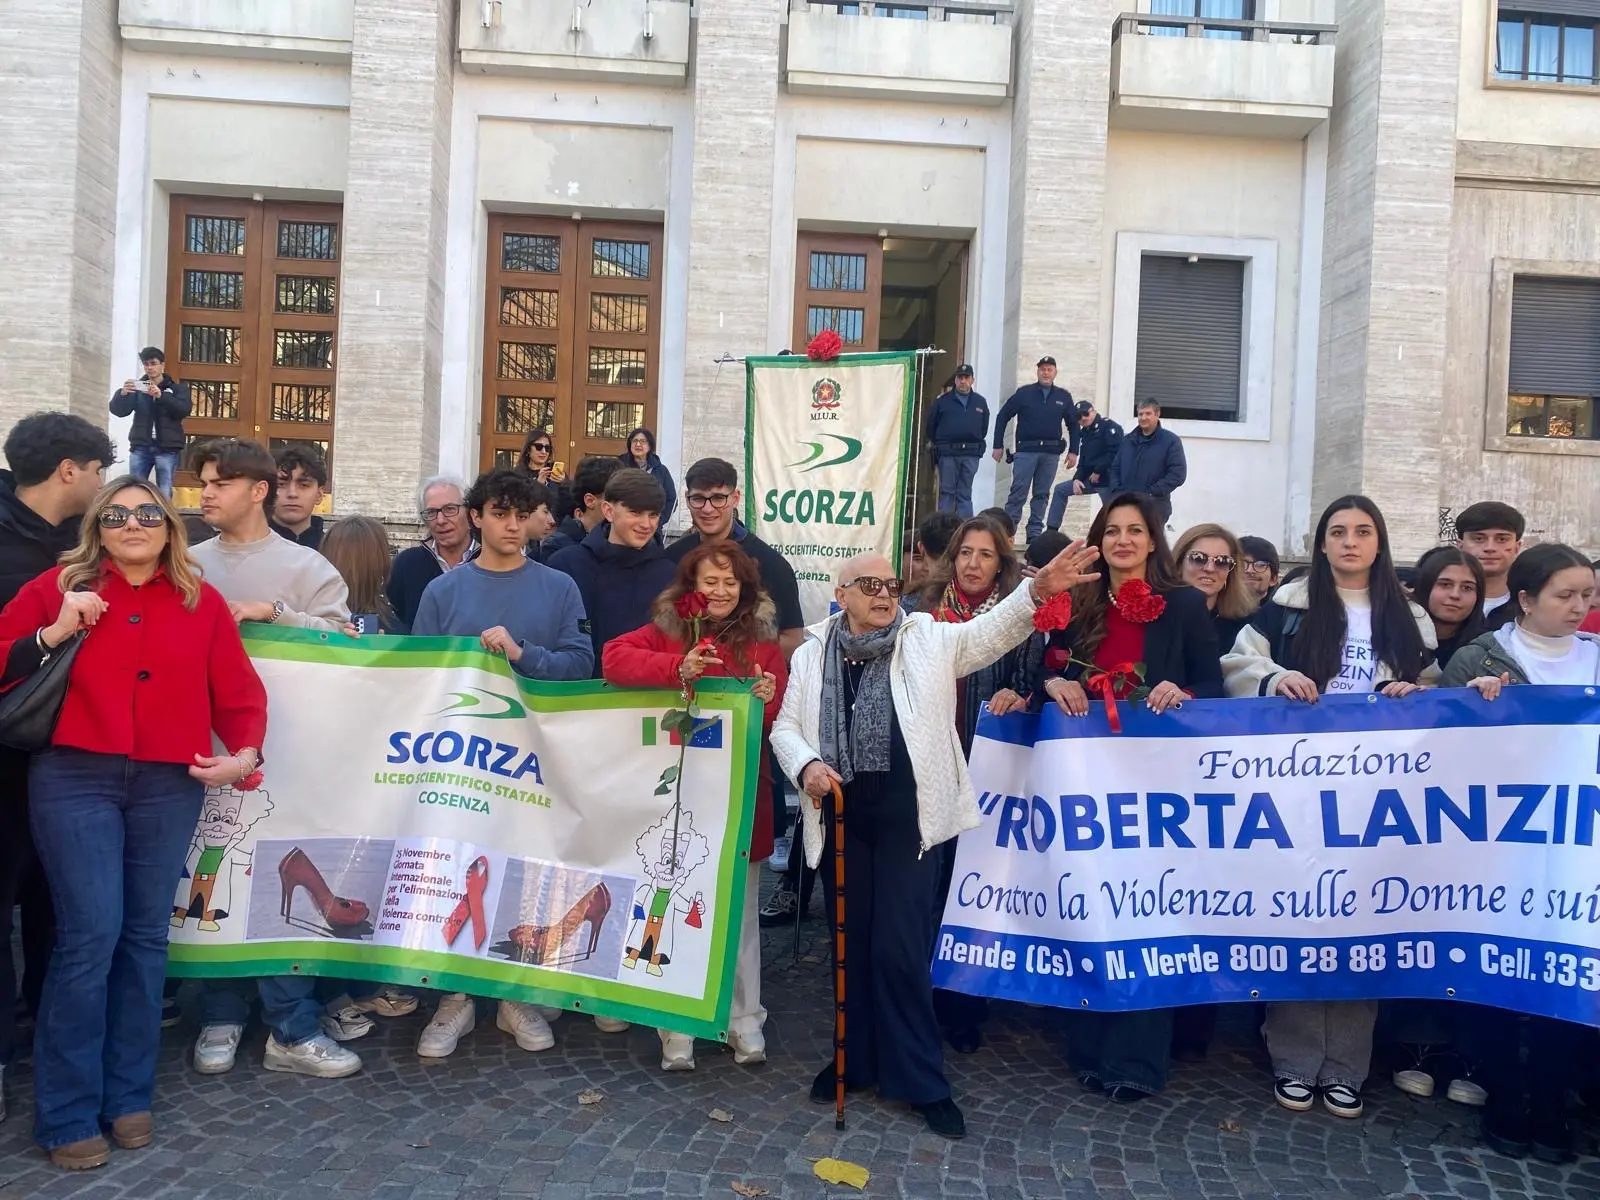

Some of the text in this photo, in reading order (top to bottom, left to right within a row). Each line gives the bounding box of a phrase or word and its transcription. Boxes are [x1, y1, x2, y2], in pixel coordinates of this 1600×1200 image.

[762, 488, 876, 526] SCORZA
[784, 544, 833, 557] SCIENTIFICO
[794, 570, 831, 582] Cosenza
[1346, 645, 1374, 661] ERT
[1339, 664, 1374, 682] ZIN
[1330, 681, 1354, 690] ODV
[386, 730, 545, 786] SCORZA
[1198, 738, 1432, 780] Fondazione
[374, 771, 552, 808] LICEO SCIENTIFICO STATALE
[418, 790, 490, 815] COSENZA
[402, 848, 451, 861] Novembre
[393, 860, 424, 870] Giornata
[391, 872, 452, 886] Internazionale
[387, 885, 397, 895] per
[957, 872, 1047, 917] Contro
[1058, 872, 1089, 921] la
[1100, 868, 1256, 919] Violenza
[1269, 869, 1357, 918] sulle
[1371, 876, 1507, 914] Donne
[1519, 887, 1535, 917] e
[385, 896, 400, 906] della
[382, 908, 414, 920] Violenza
[379, 920, 400, 931] donne
[938, 933, 1600, 992] Rende (Cs) N. Verde 800 28 88 50 Cell. 333
